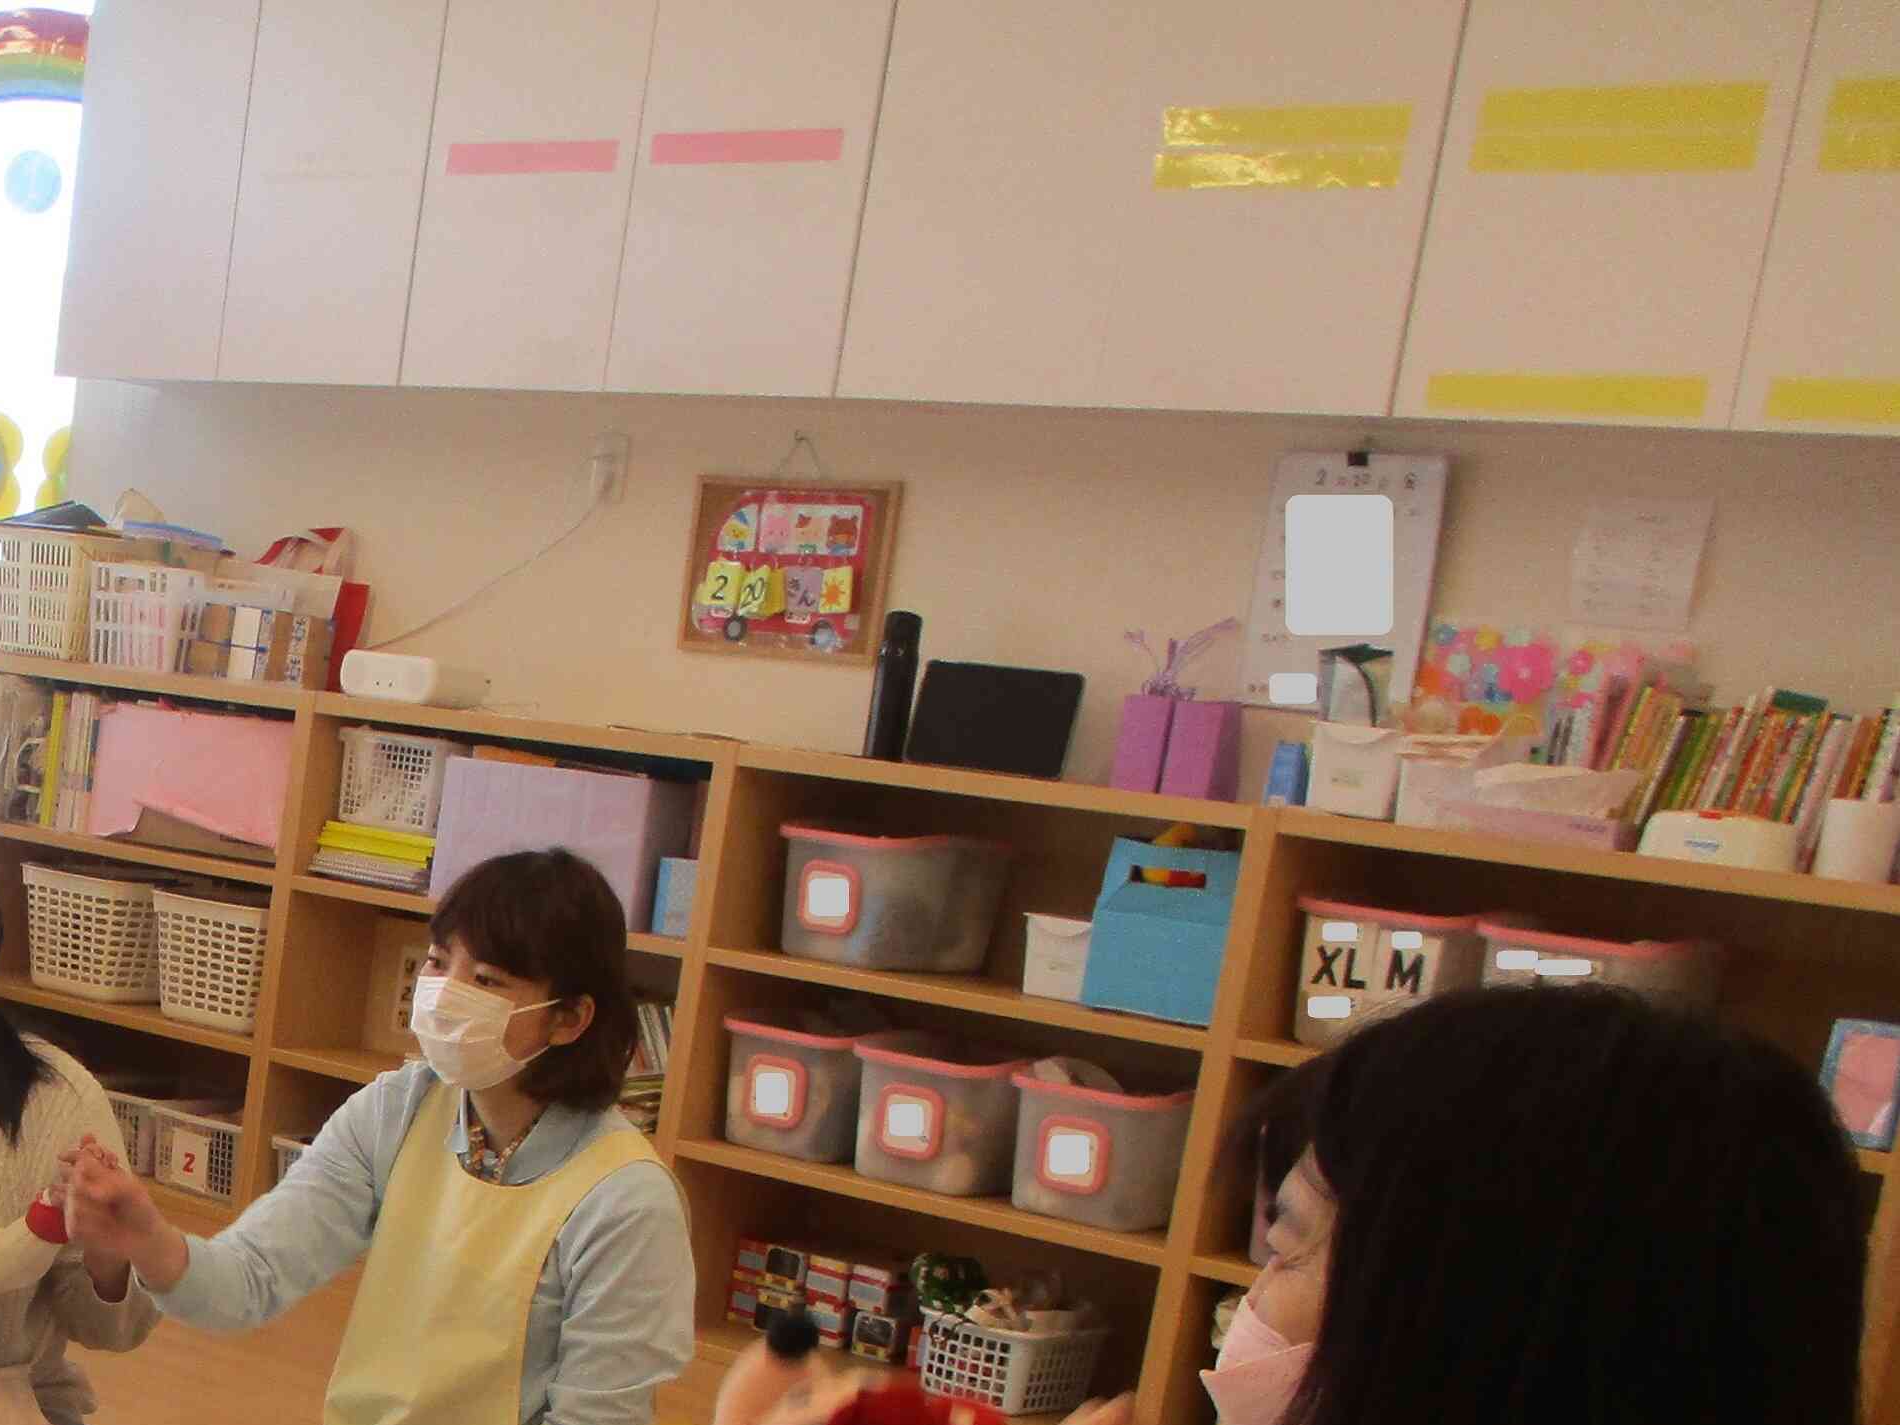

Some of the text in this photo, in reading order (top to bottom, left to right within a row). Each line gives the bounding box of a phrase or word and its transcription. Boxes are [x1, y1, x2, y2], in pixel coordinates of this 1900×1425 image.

[711, 575, 728, 600] 2
[740, 576, 765, 609] 20
[1310, 944, 1366, 989] XL
[1384, 949, 1426, 993] M
[182, 1151, 196, 1174] 2
